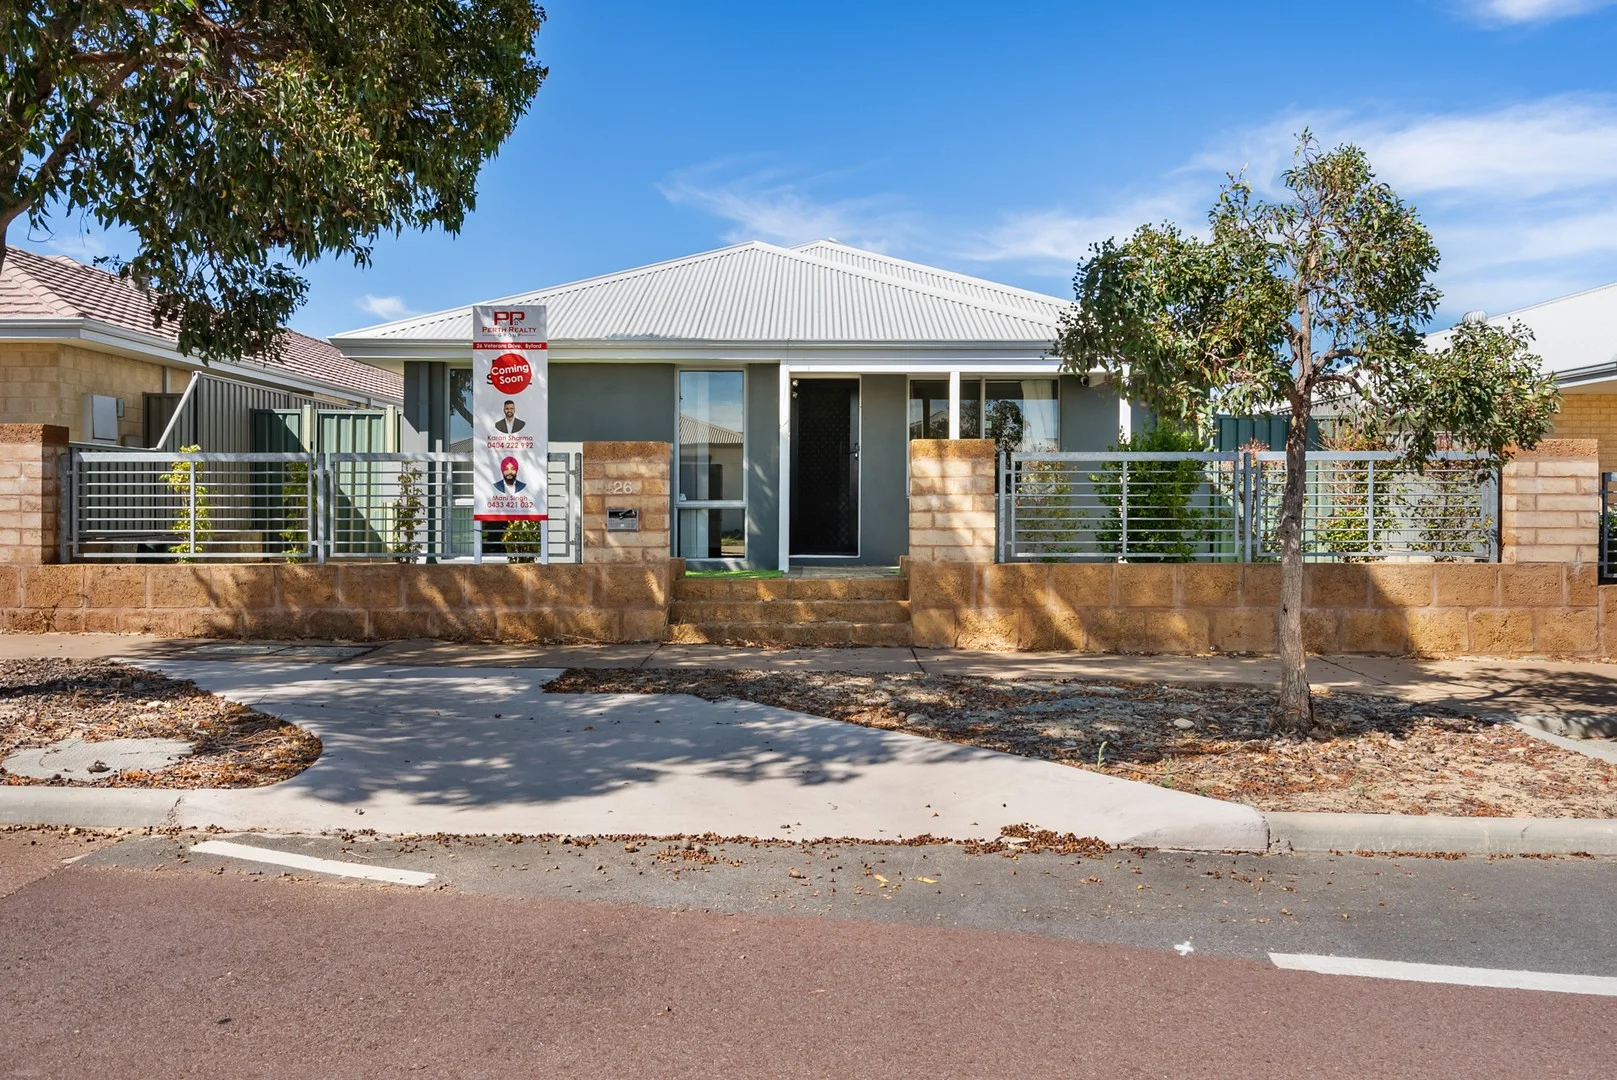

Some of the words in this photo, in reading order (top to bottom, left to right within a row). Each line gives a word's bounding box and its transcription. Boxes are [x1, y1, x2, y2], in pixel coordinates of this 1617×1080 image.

[491, 364, 529, 375] Coming
[499, 375, 523, 384] Soon
[613, 481, 632, 494] 26
